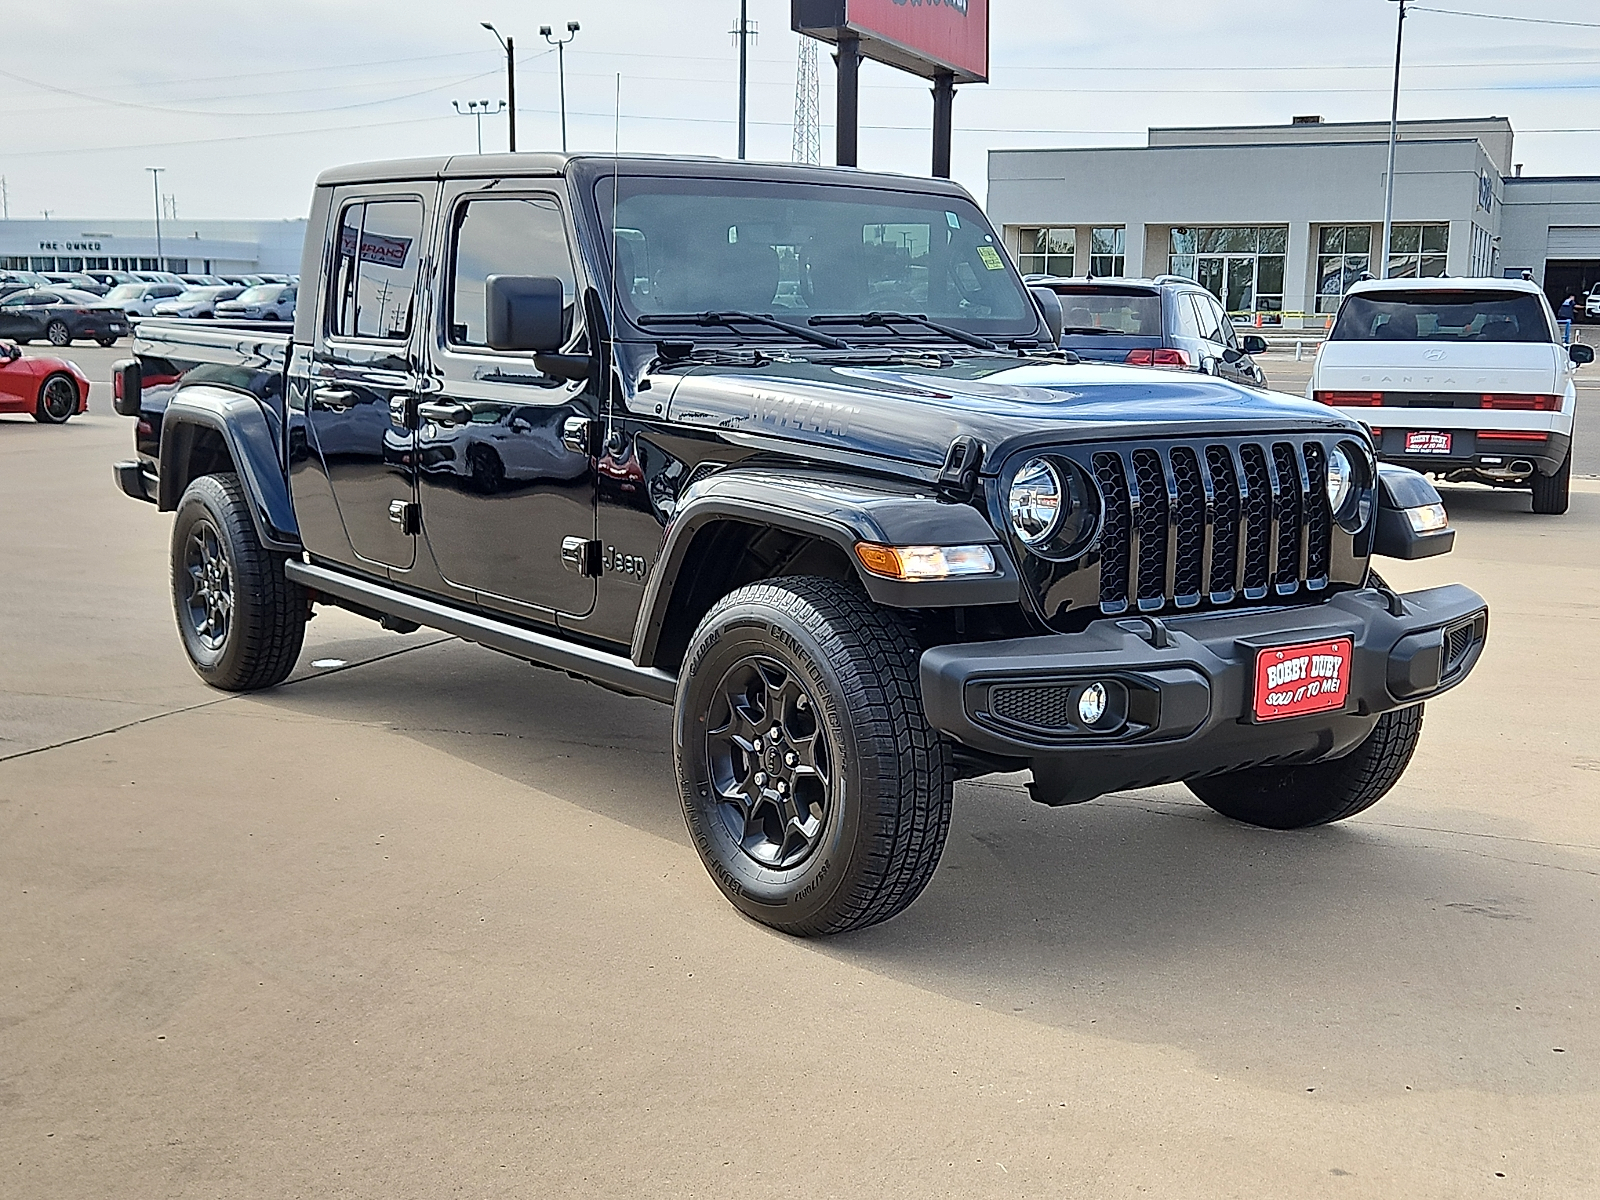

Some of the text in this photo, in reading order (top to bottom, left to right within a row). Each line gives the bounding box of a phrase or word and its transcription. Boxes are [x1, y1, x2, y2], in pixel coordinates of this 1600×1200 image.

[1360, 374, 1509, 385] SANTA FE
[603, 545, 647, 581] Jeep
[1267, 655, 1342, 689] BOBBY DUBY
[1266, 679, 1340, 705] SOLD IT TO ME!
